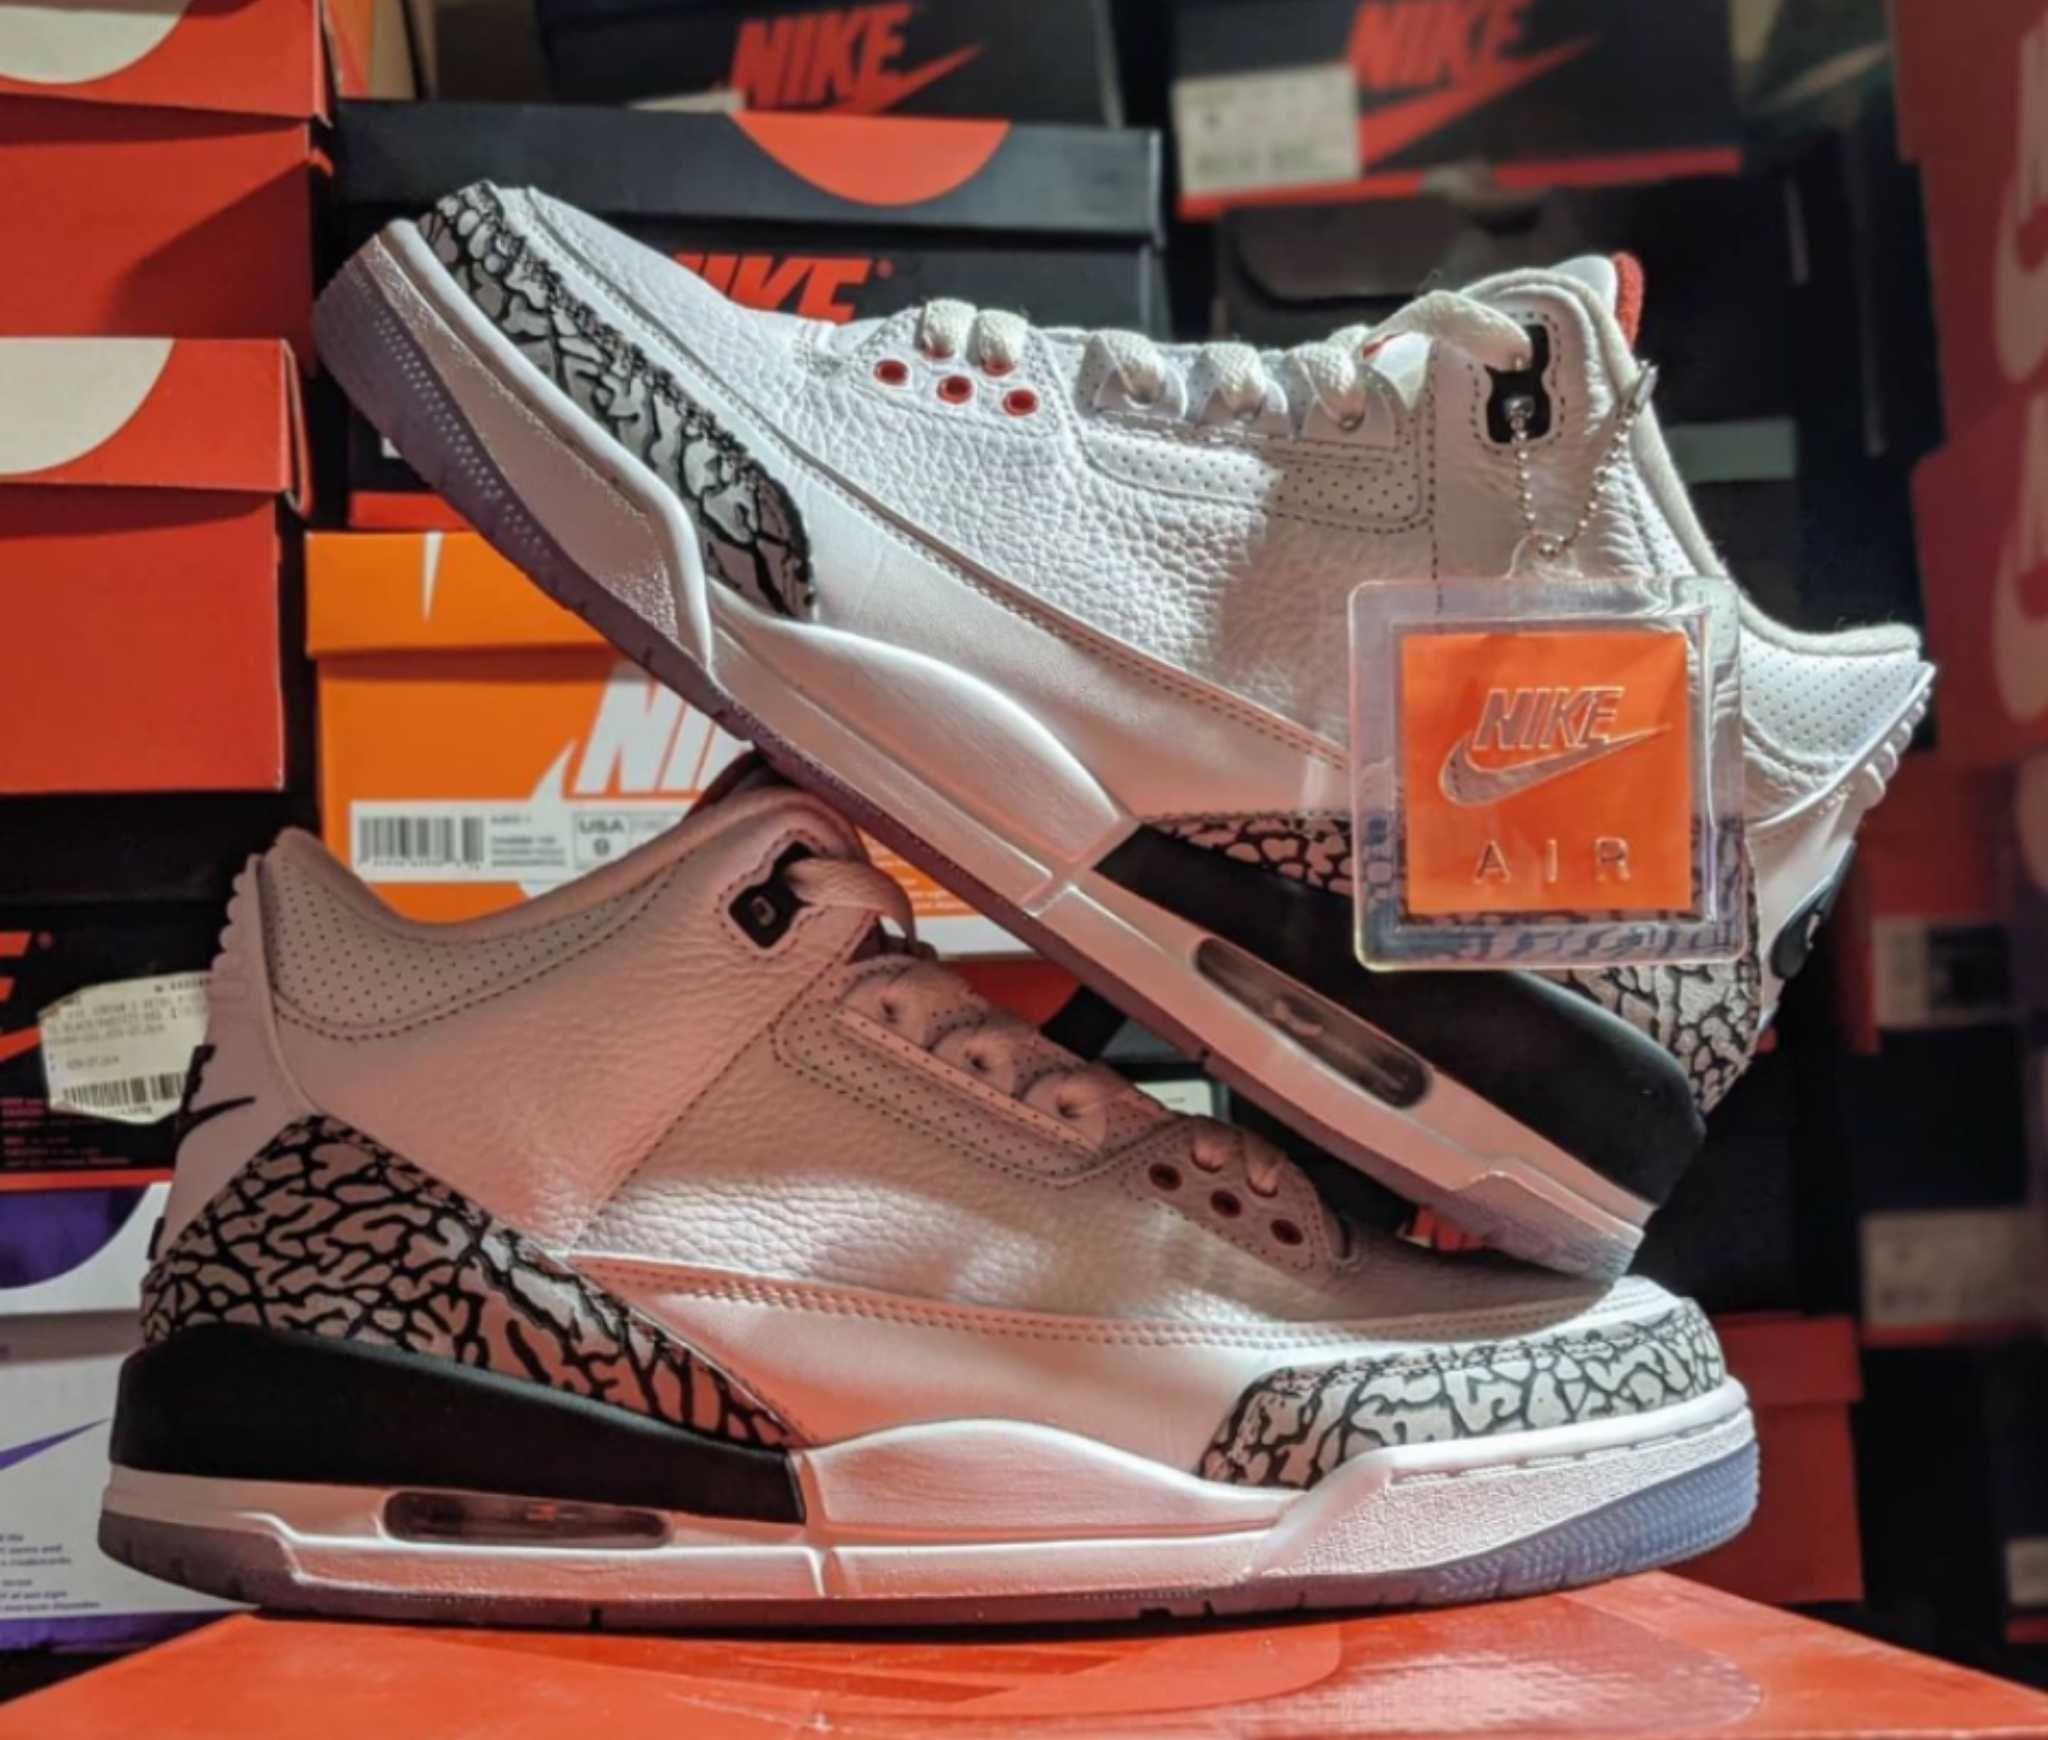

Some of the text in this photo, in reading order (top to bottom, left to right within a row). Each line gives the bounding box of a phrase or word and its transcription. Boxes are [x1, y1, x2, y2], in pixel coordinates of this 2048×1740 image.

[731, 2, 911, 109] NIKE
[1471, 685, 1626, 751] NIKE
[578, 819, 625, 834] USA
[1472, 836, 1632, 885] AIR
